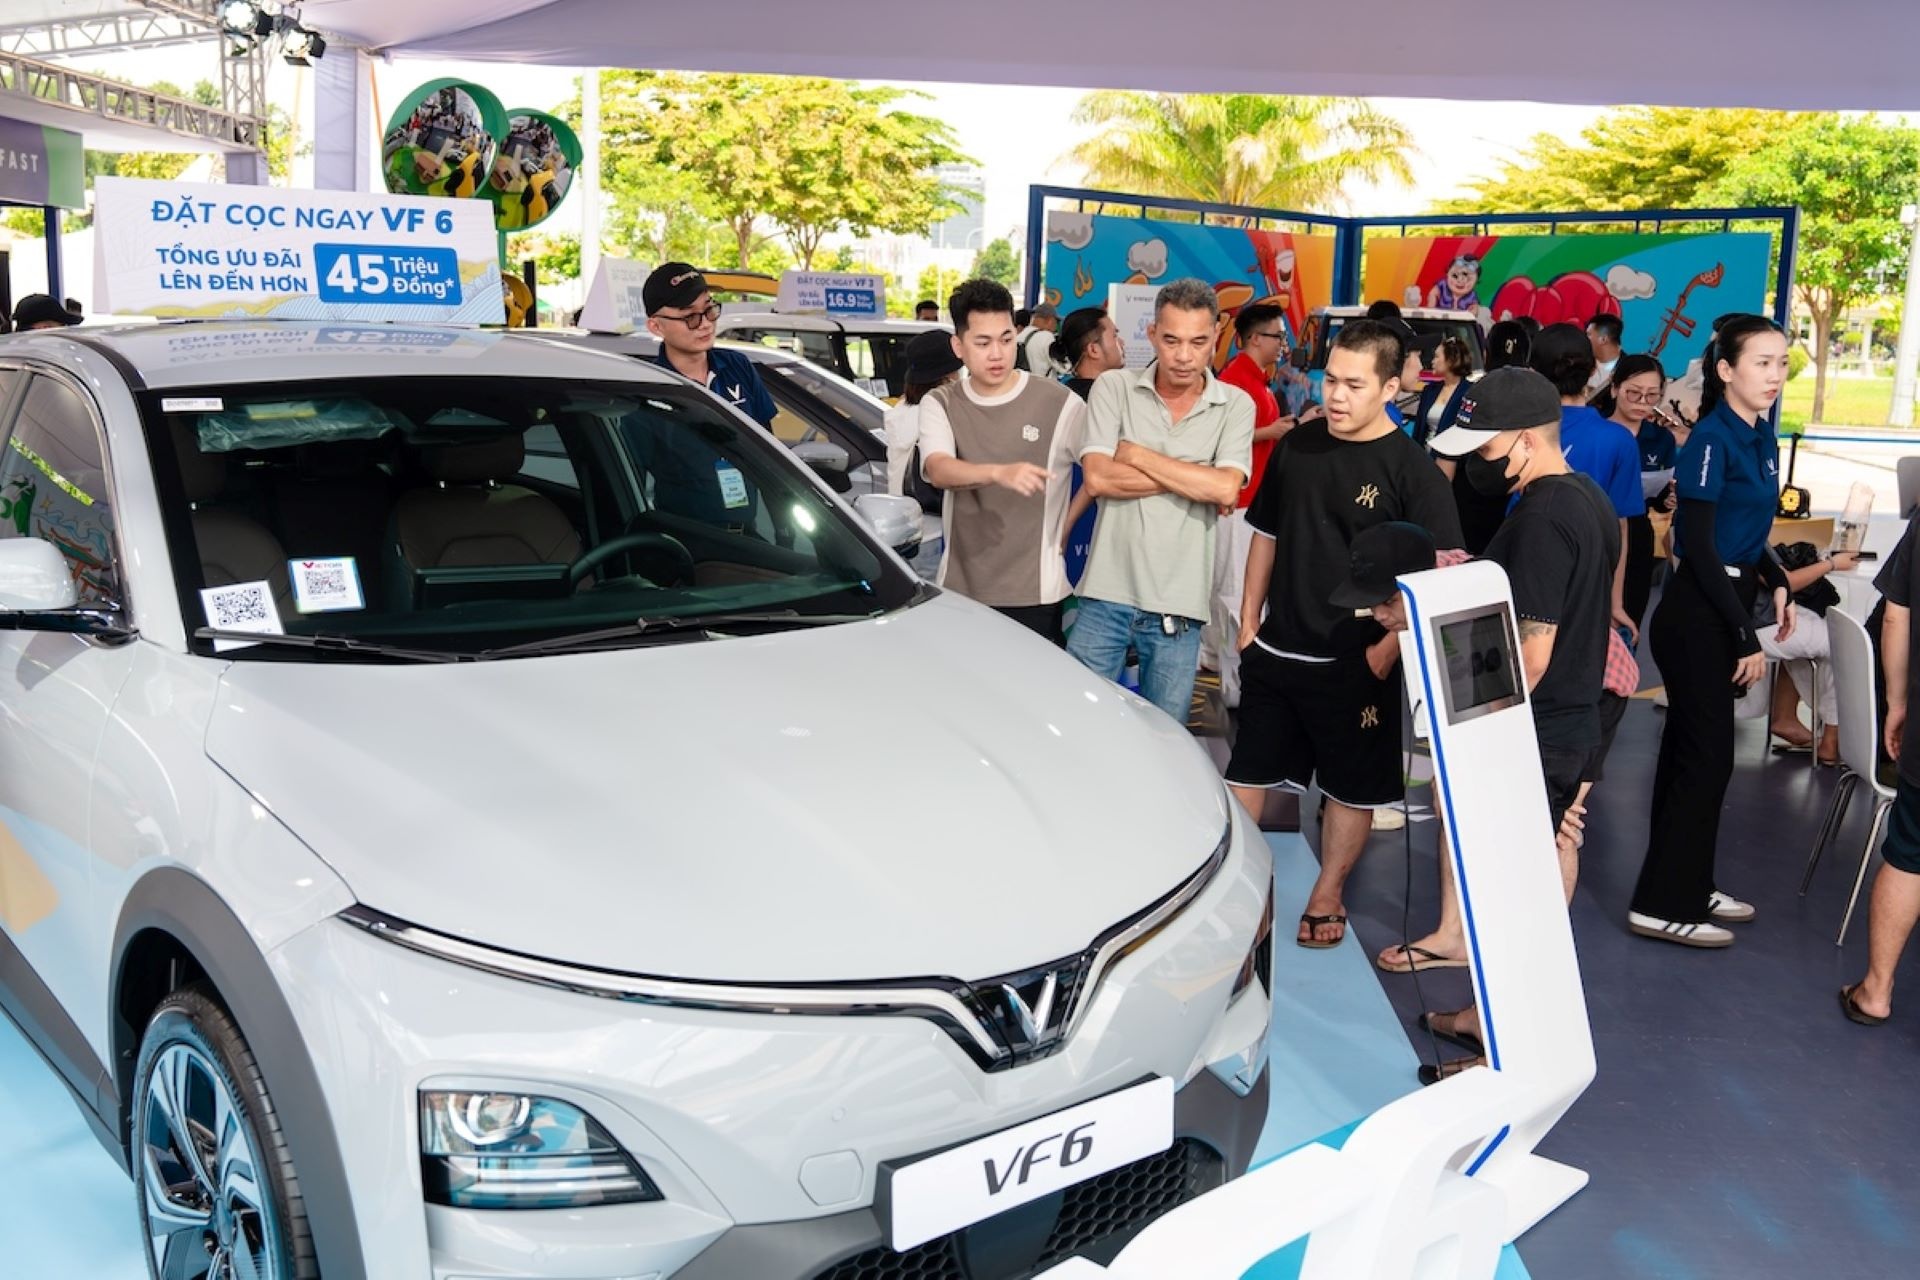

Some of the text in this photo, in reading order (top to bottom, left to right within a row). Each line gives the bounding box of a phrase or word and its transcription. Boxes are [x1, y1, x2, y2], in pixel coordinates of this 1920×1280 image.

[151, 195, 454, 234] ĐẶT CỌC NGAY VF 6
[155, 242, 302, 268] TỔNG ƯU ĐÃI
[389, 256, 440, 279] Triệu
[159, 268, 309, 292] LÊN ĐẾN HƠN
[325, 252, 390, 295] 45
[827, 292, 857, 308] 16.9
[983, 1120, 1096, 1196] VF6
